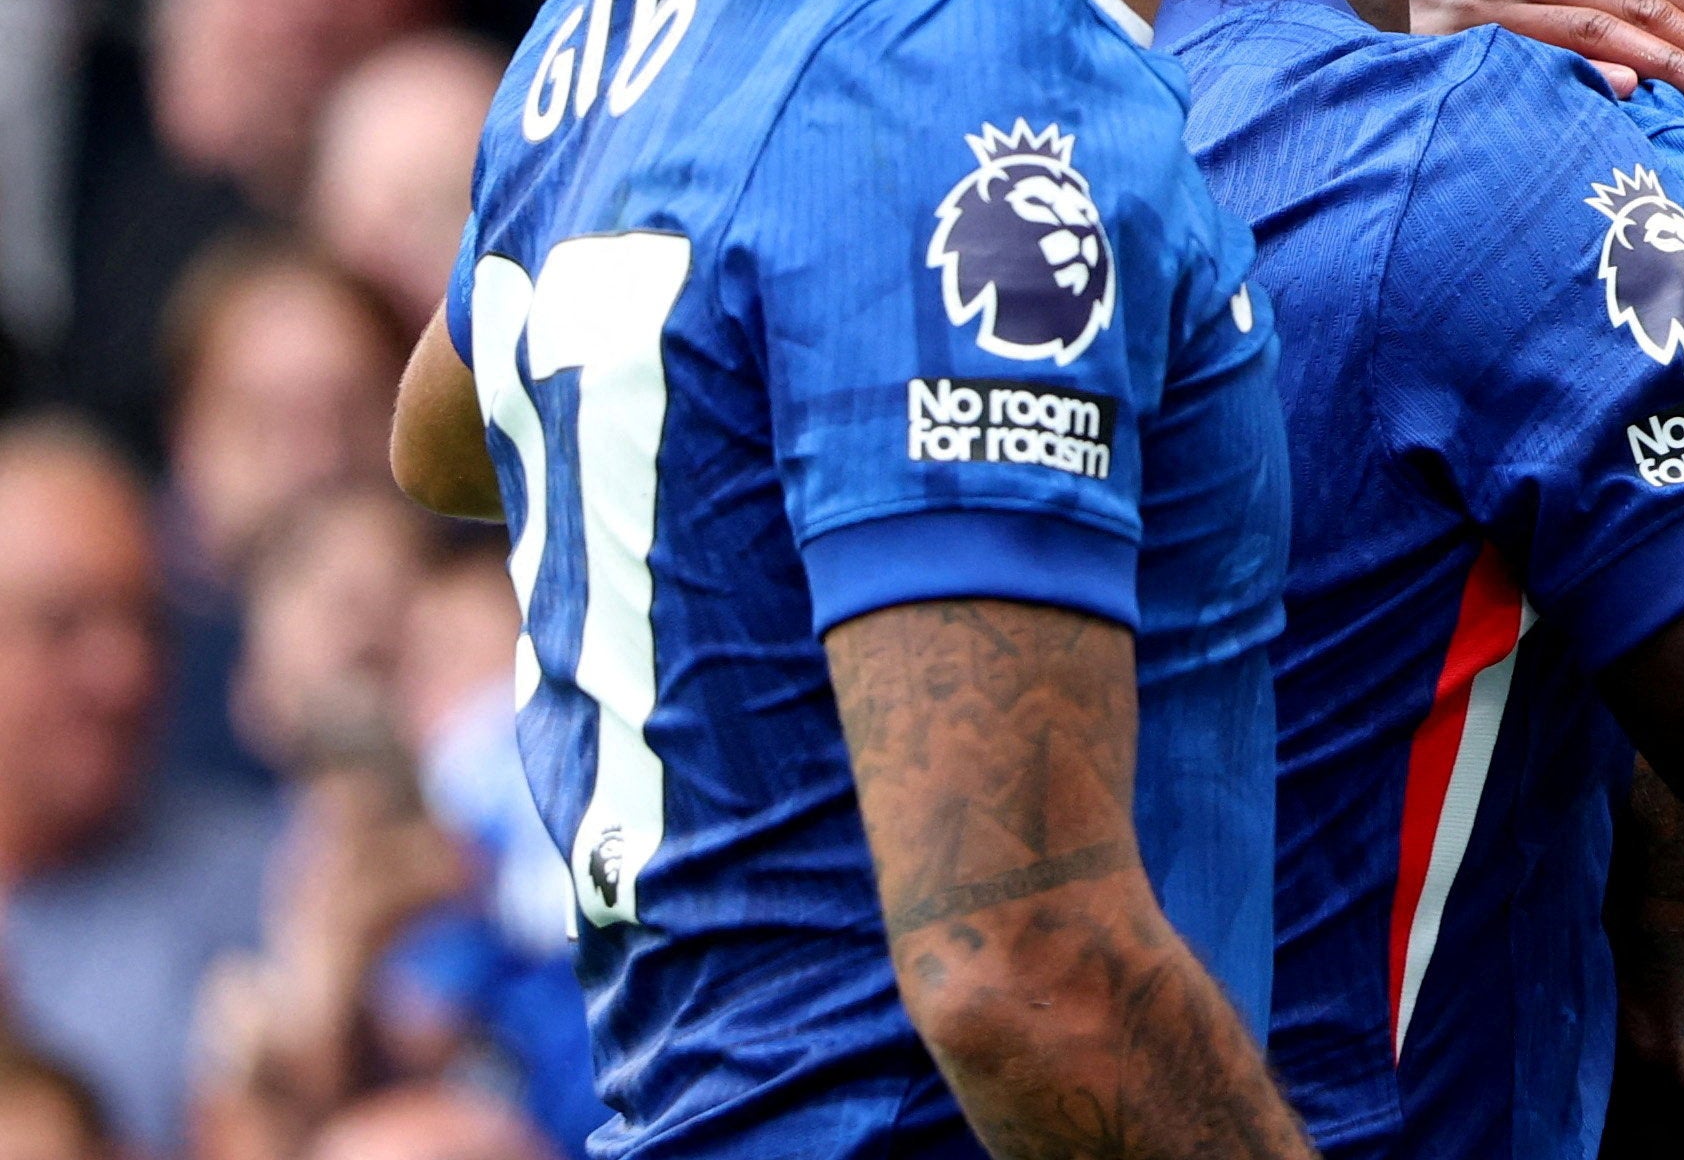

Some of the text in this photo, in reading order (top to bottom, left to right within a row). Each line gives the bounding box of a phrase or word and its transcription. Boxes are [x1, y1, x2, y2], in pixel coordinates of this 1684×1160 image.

[907, 378, 1100, 439] No room
[907, 417, 1110, 480] for racism
